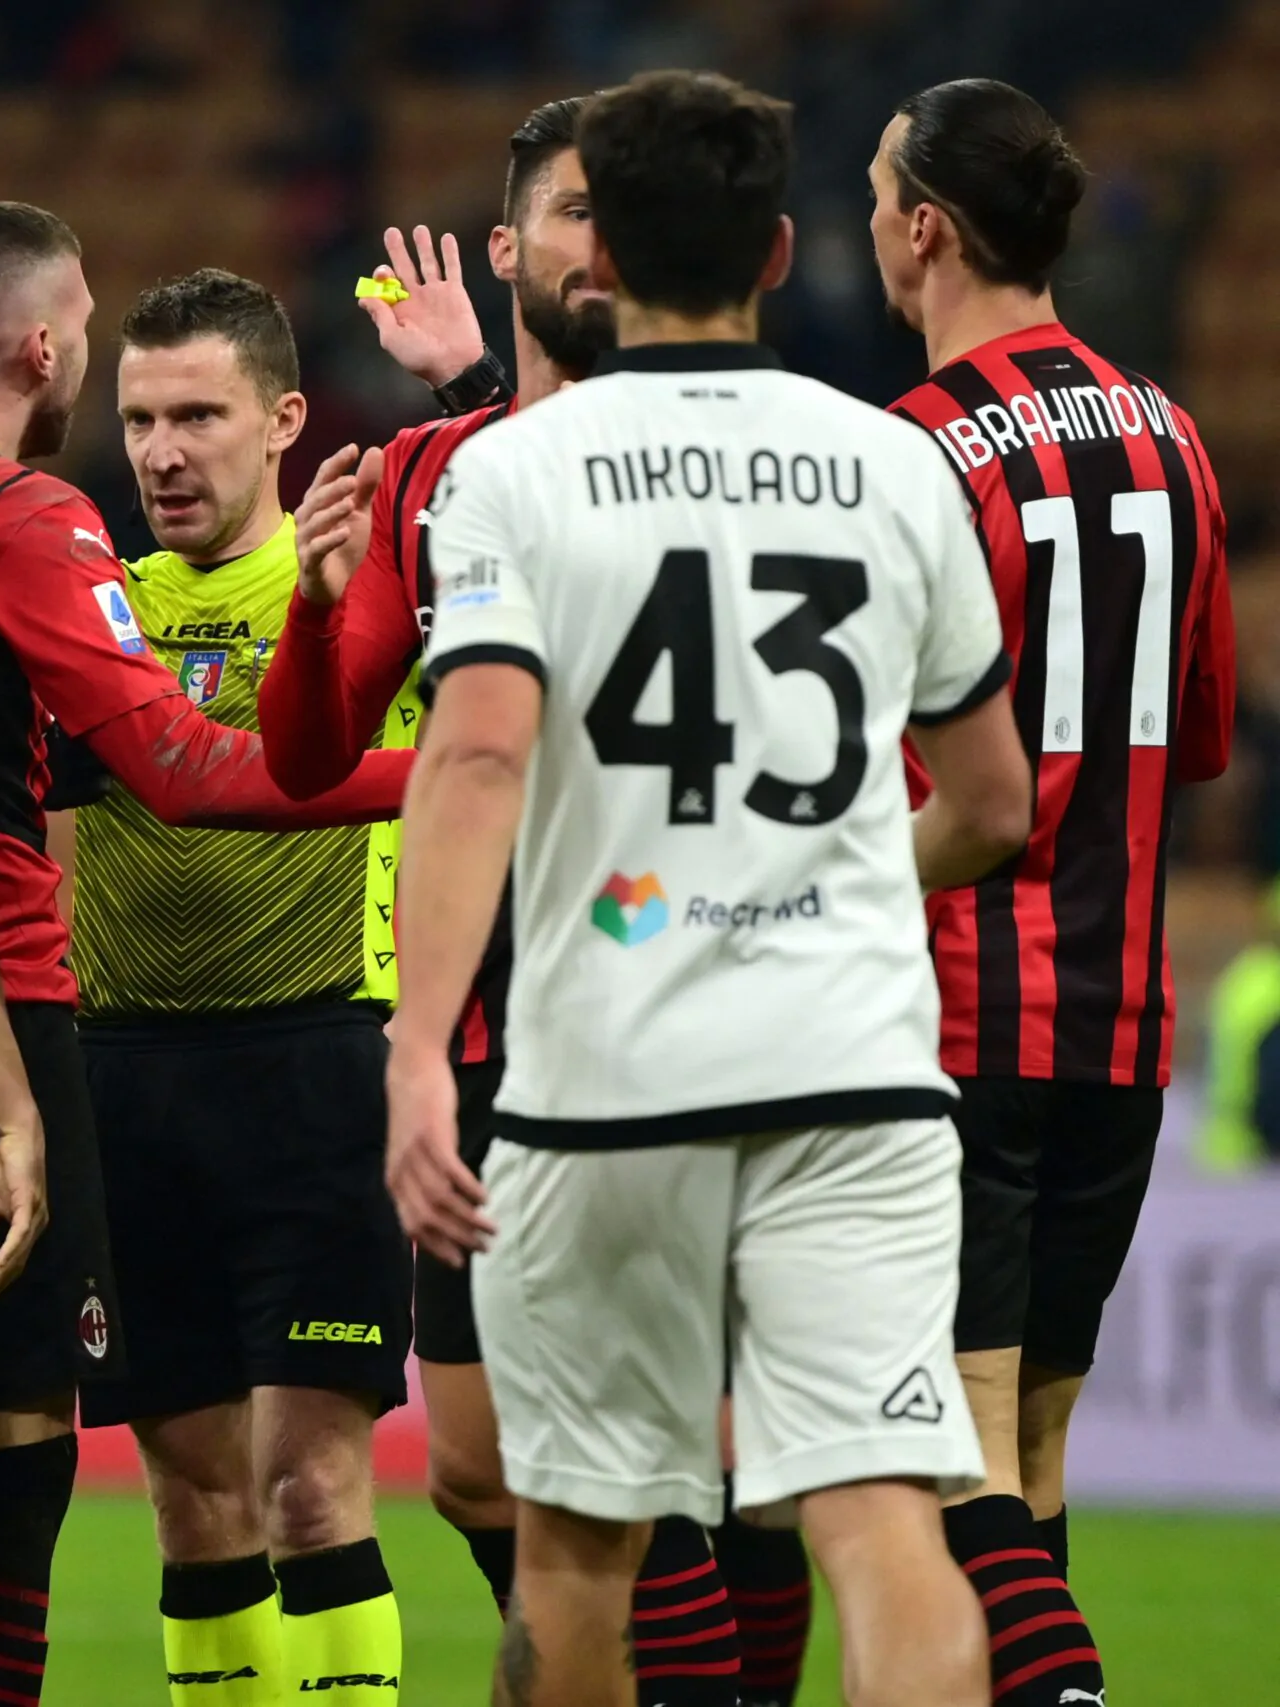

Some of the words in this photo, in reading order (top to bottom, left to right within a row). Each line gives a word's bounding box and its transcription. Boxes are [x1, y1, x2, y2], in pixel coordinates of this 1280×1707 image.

[585, 446, 862, 508] NIKOLAOU
[1021, 490, 1173, 753] 11
[187, 653, 219, 661] ITALIA
[583, 548, 870, 826] 43
[288, 1321, 383, 1345] LEGEA
[300, 1674, 398, 1691] LEGEA
